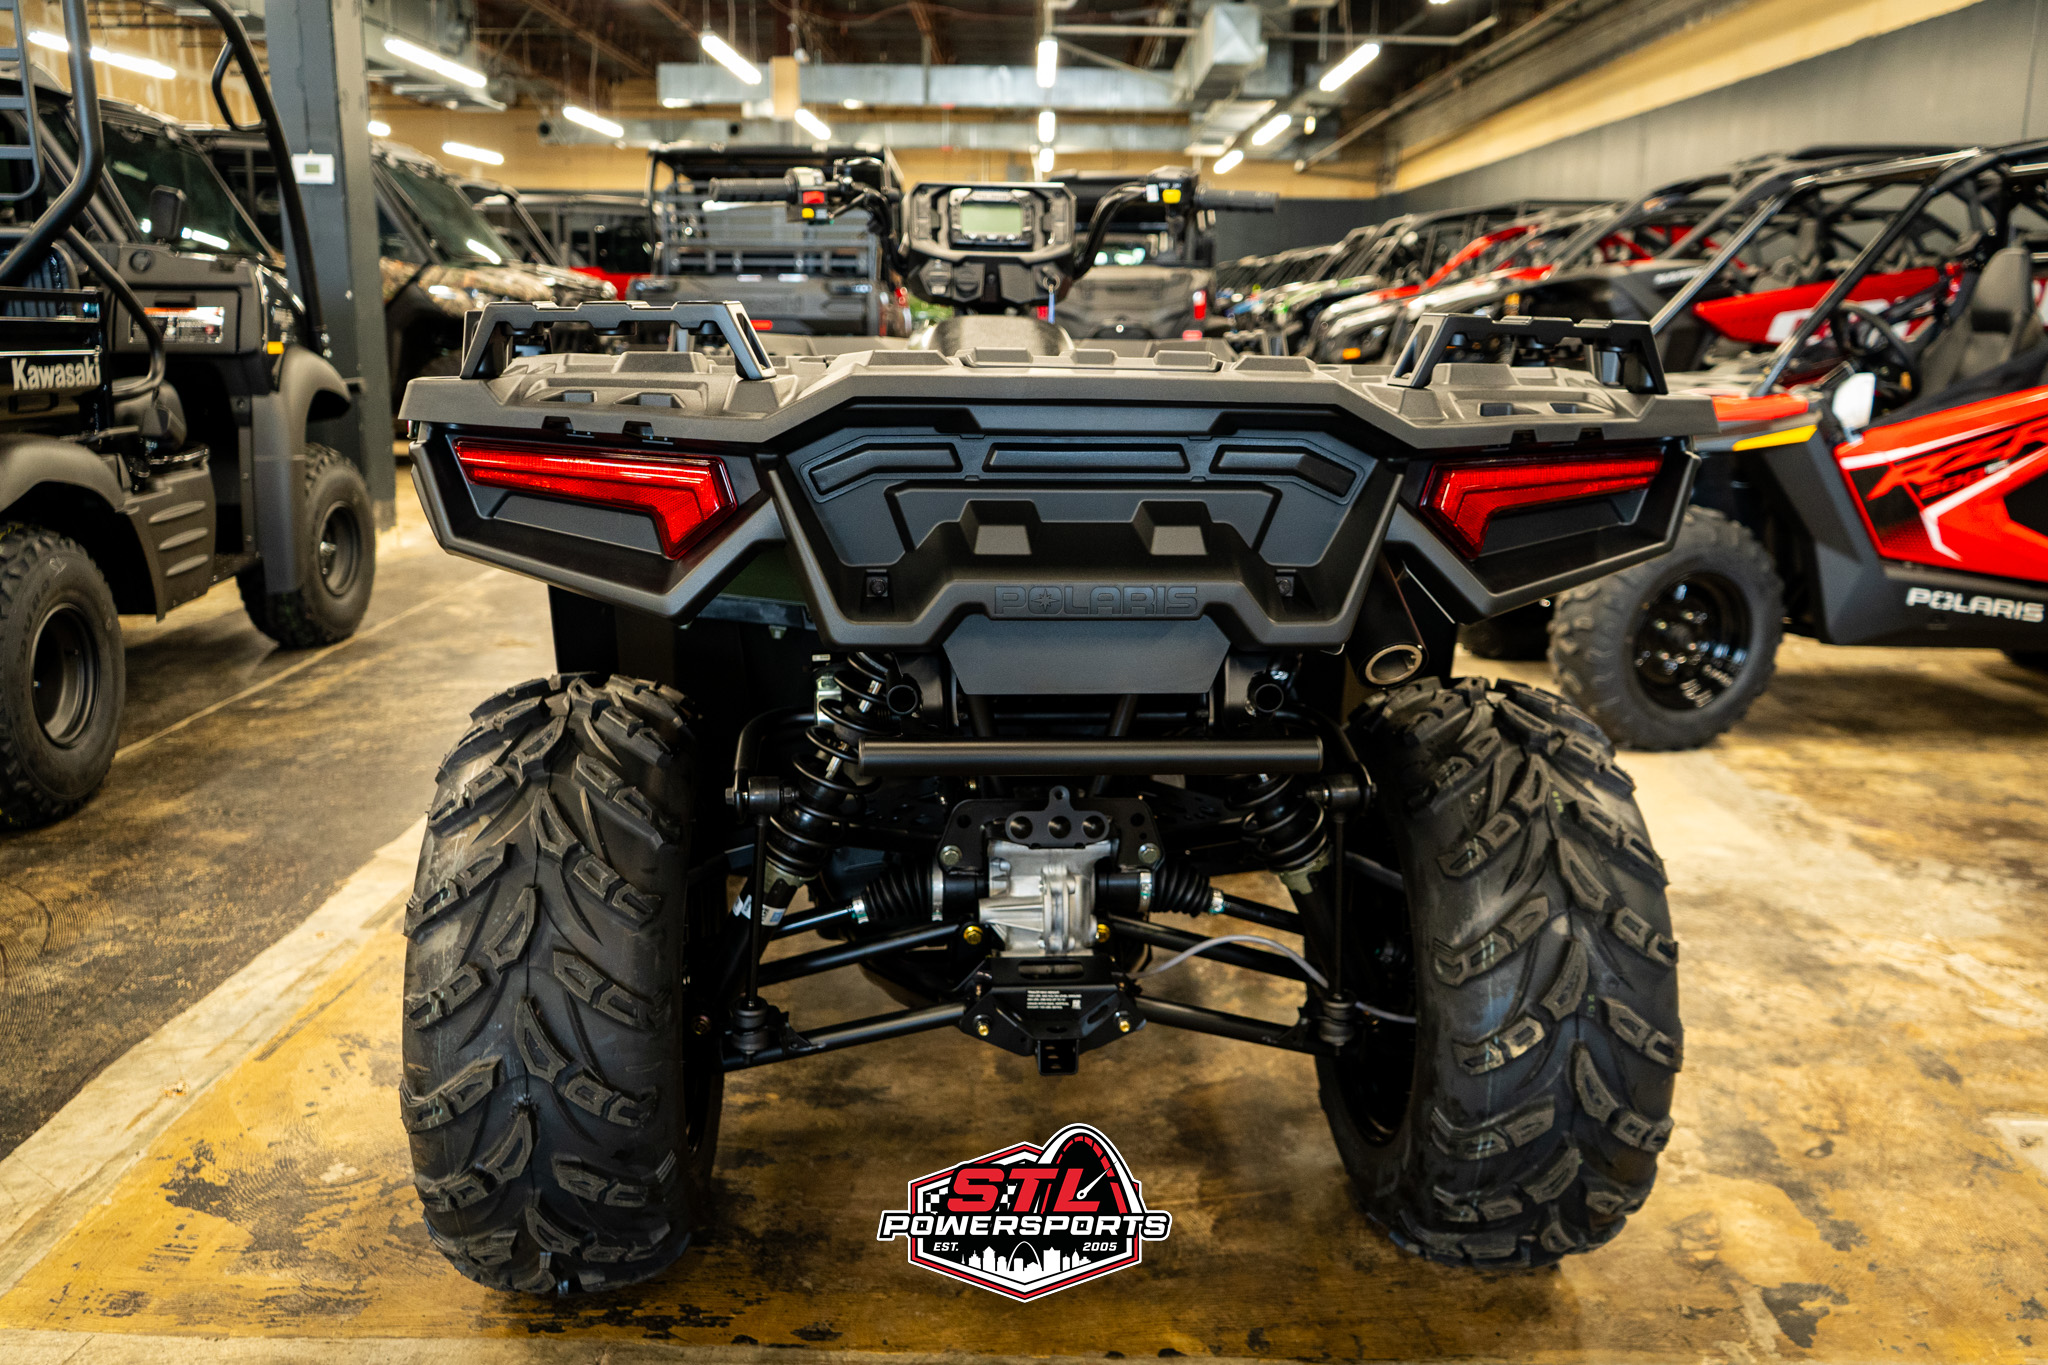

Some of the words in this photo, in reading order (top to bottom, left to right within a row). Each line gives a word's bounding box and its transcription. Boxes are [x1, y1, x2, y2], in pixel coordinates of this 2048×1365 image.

[11, 355, 100, 391] Kawasaki
[994, 585, 1199, 615] POLARIS
[1906, 587, 2045, 623] POLARIS
